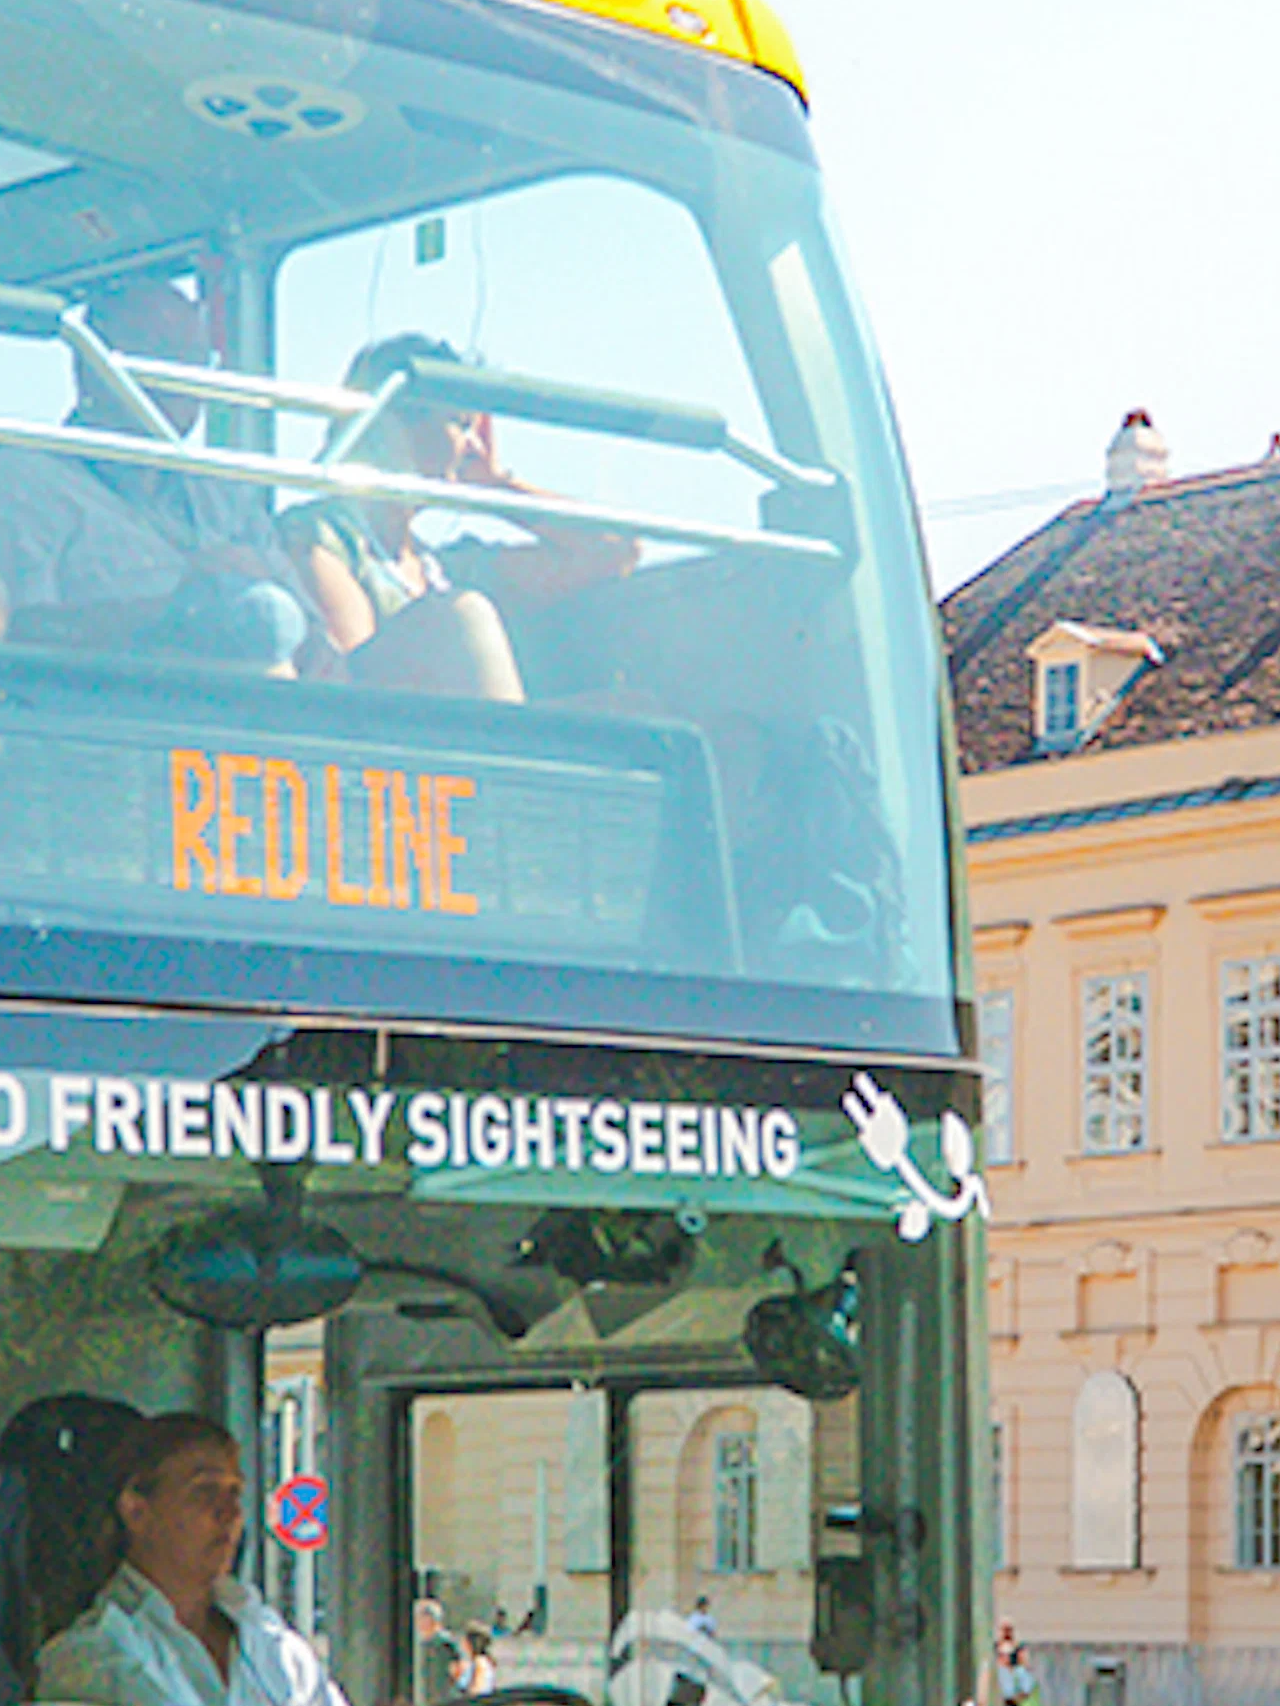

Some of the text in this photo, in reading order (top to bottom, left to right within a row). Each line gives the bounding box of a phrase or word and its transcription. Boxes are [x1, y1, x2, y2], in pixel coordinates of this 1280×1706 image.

[171, 749, 478, 914] RED LINE
[50, 1076, 395, 1164] FRIENDLY
[407, 1093, 799, 1178] SIGHTSEEING
